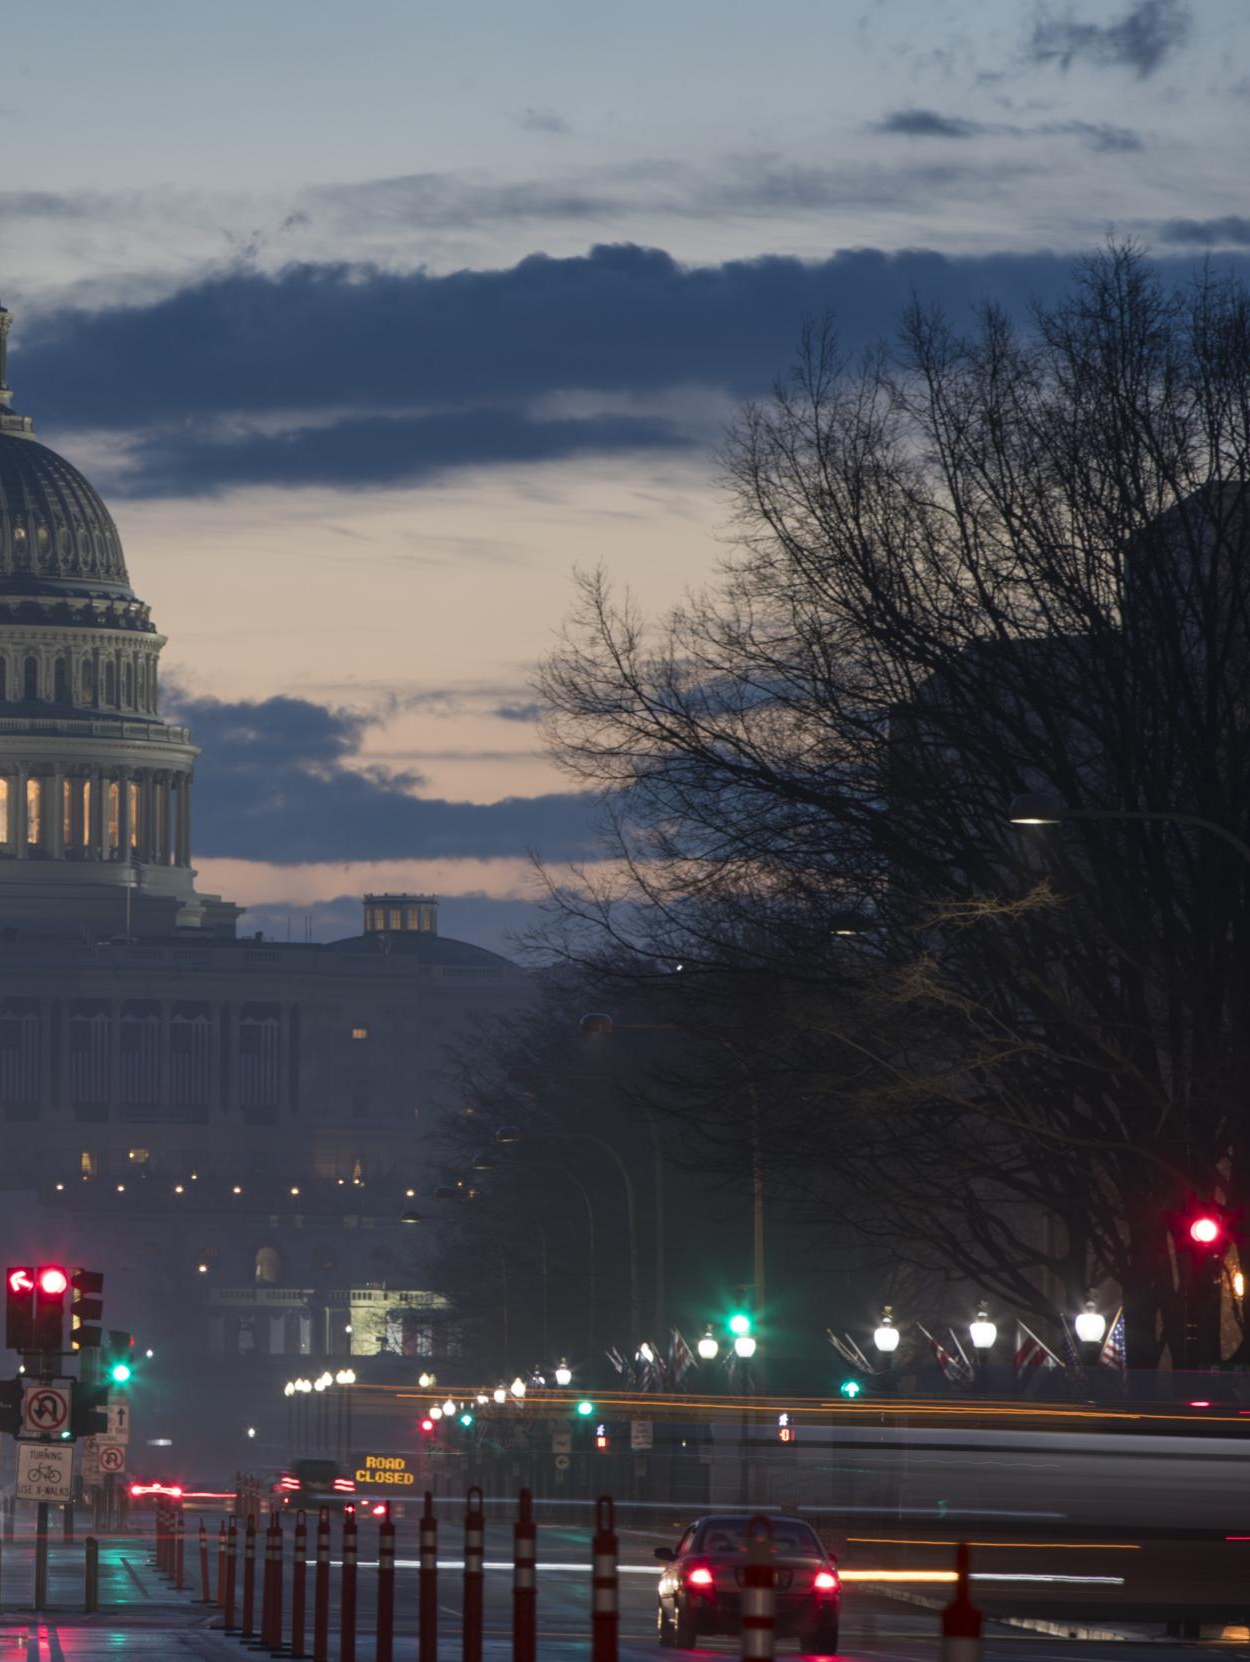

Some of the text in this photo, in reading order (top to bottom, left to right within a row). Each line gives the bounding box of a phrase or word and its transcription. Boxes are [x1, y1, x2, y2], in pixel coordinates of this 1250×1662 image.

[30, 1450, 62, 1461] TURNING
[365, 1456, 405, 1470] ROAD
[355, 1470, 414, 1485] CLOSED
